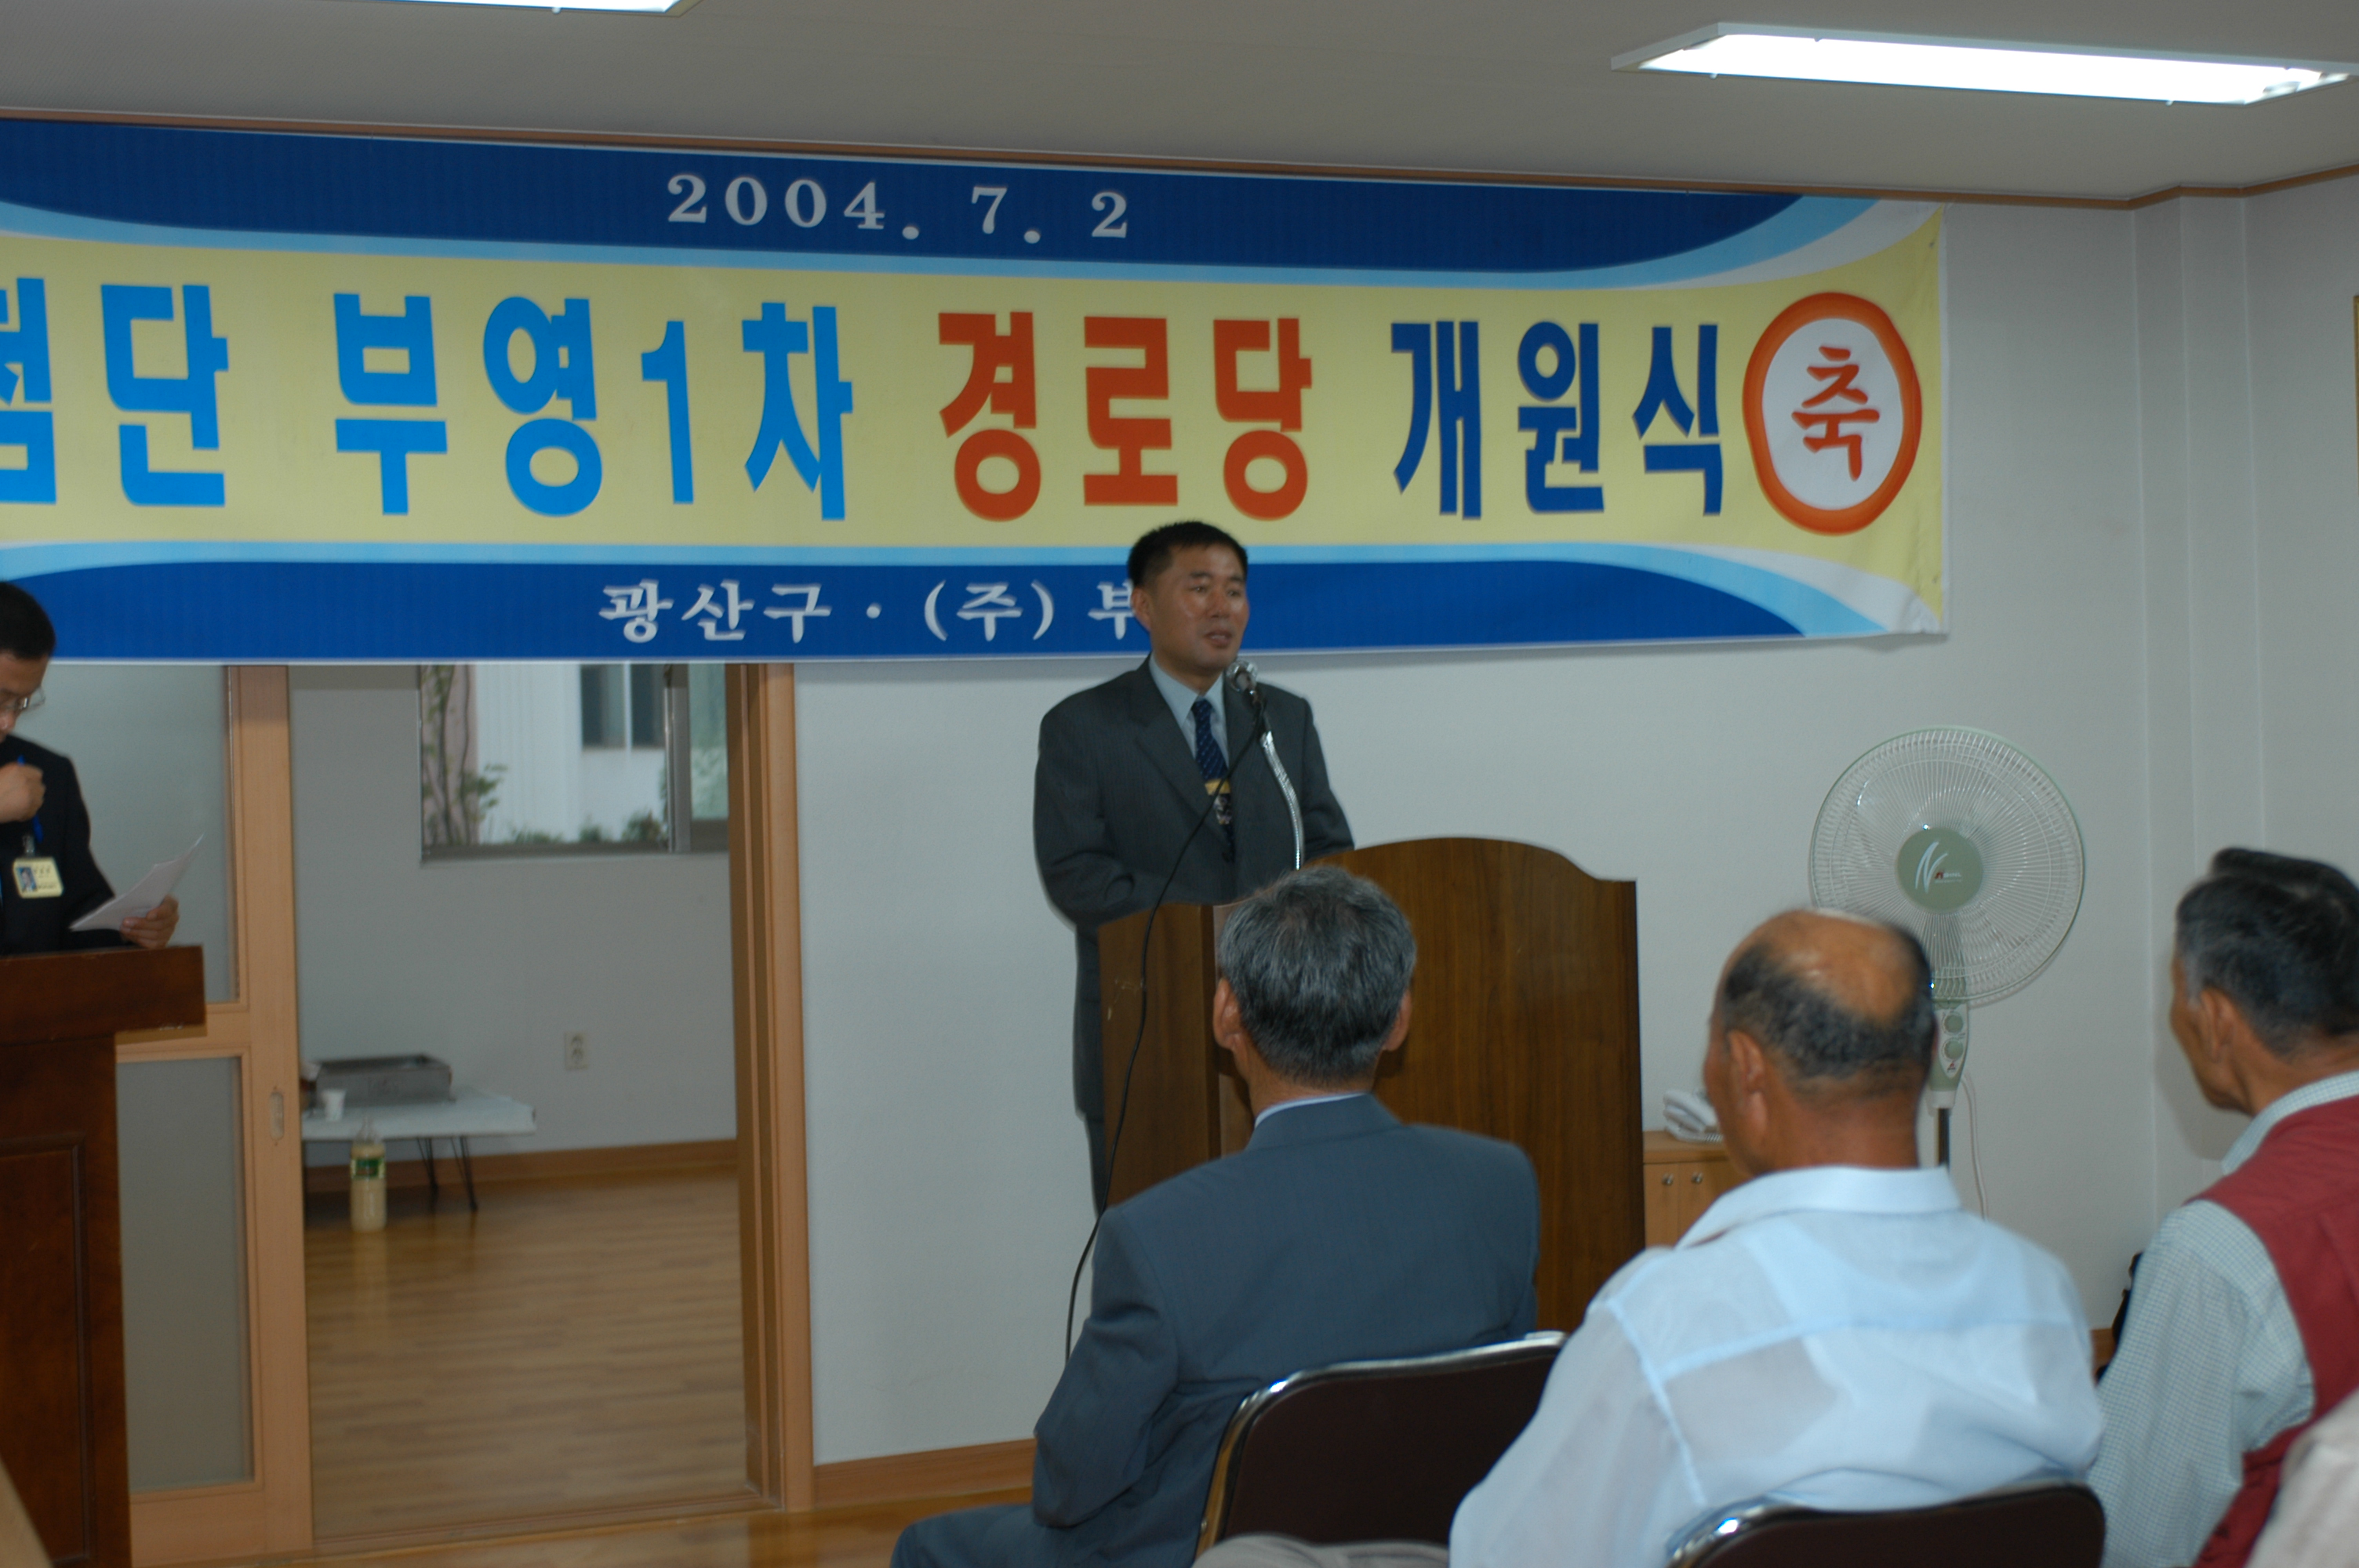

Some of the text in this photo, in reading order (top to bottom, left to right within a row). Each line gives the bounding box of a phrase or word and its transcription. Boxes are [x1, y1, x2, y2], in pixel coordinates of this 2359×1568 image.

[667, 174, 920, 240] 2004.
[1091, 191, 1128, 238] 2
[334, 293, 853, 521] 부영1차
[938, 310, 1313, 523] 경로당
[1391, 321, 1724, 519] 개원식
[1791, 345, 1880, 481] 축
[598, 579, 832, 644] 광산구
[924, 580, 1055, 641] (주)
